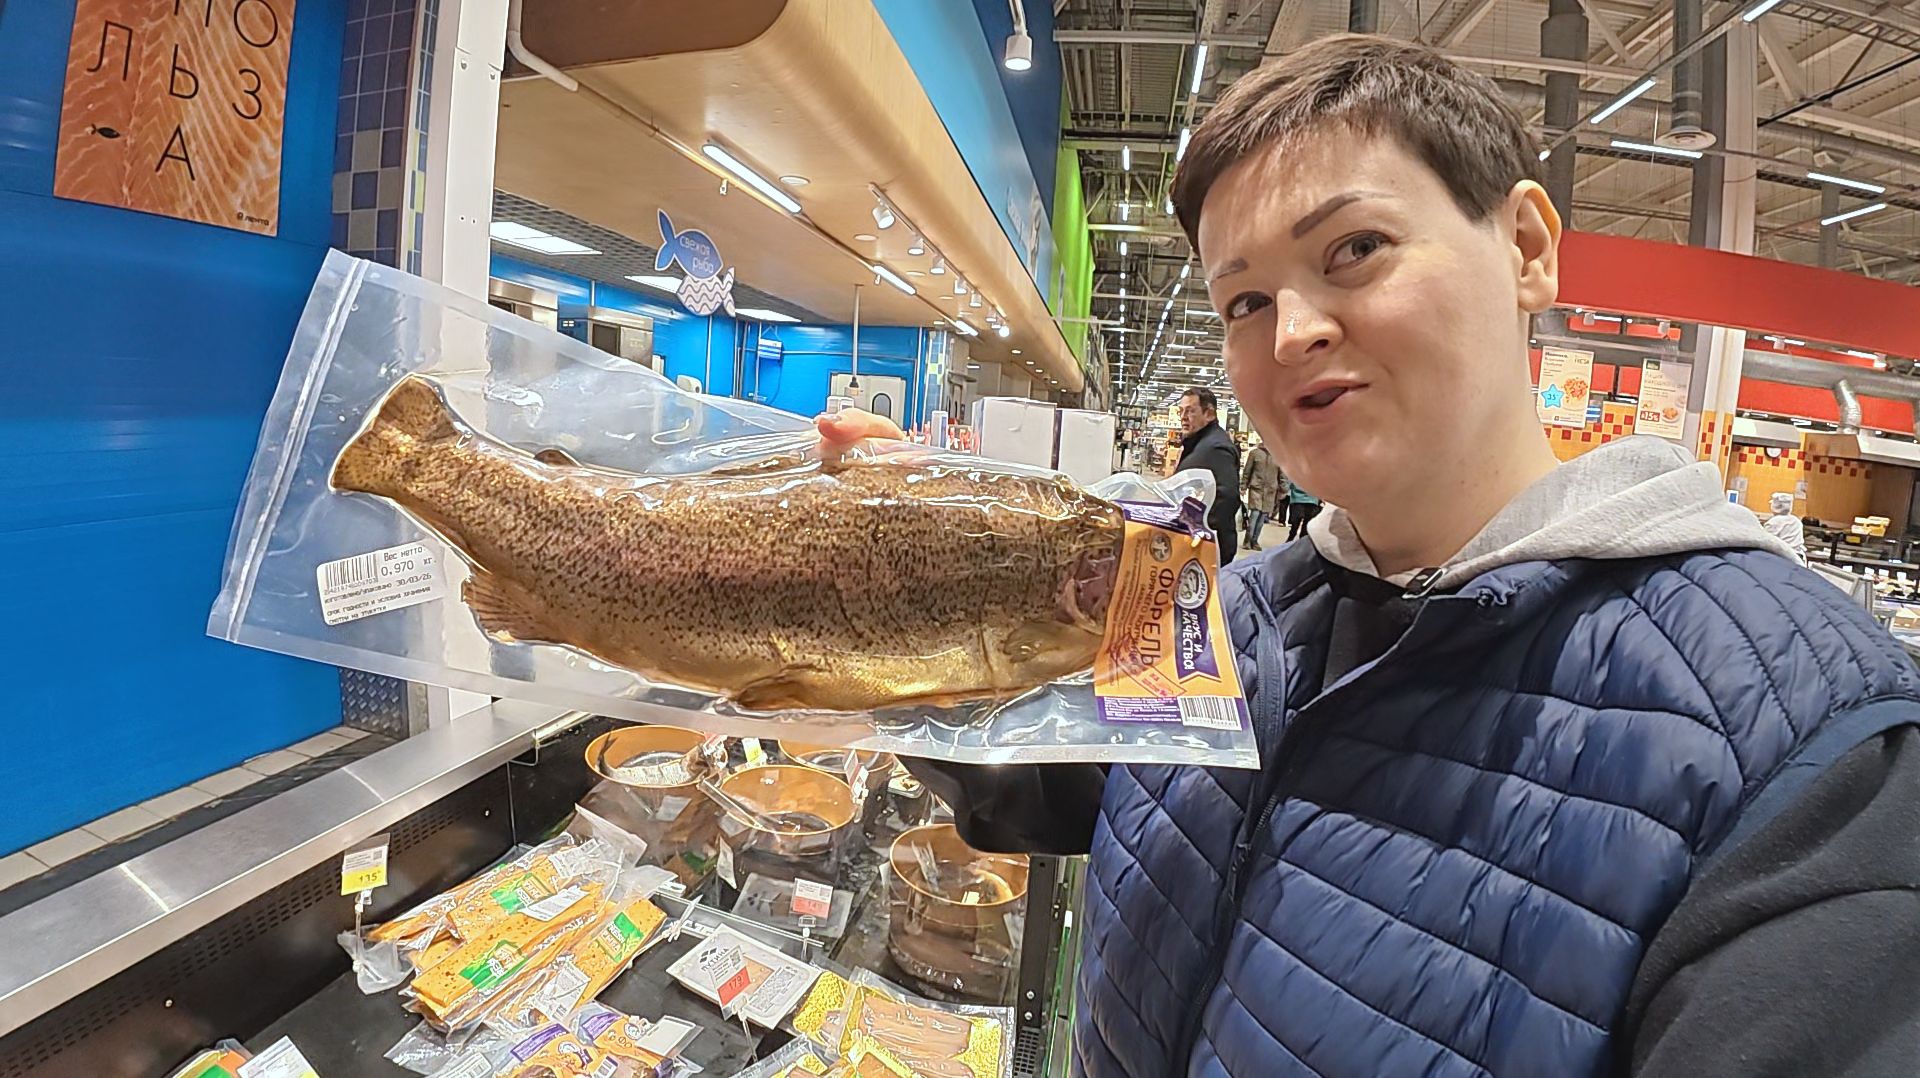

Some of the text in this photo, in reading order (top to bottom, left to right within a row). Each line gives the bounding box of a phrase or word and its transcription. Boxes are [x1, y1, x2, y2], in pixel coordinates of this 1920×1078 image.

[692, 256, 714, 274] рыба
[380, 560, 414, 577] 0.970
[383, 552, 398, 562] Вес
[1140, 568, 1175, 665] ФОРЕЛЬ
[1181, 609, 1195, 670] КАЧЕСТВО!
[1189, 613, 1204, 653] ВКУС И
[701, 947, 730, 972] ПУТИНА
